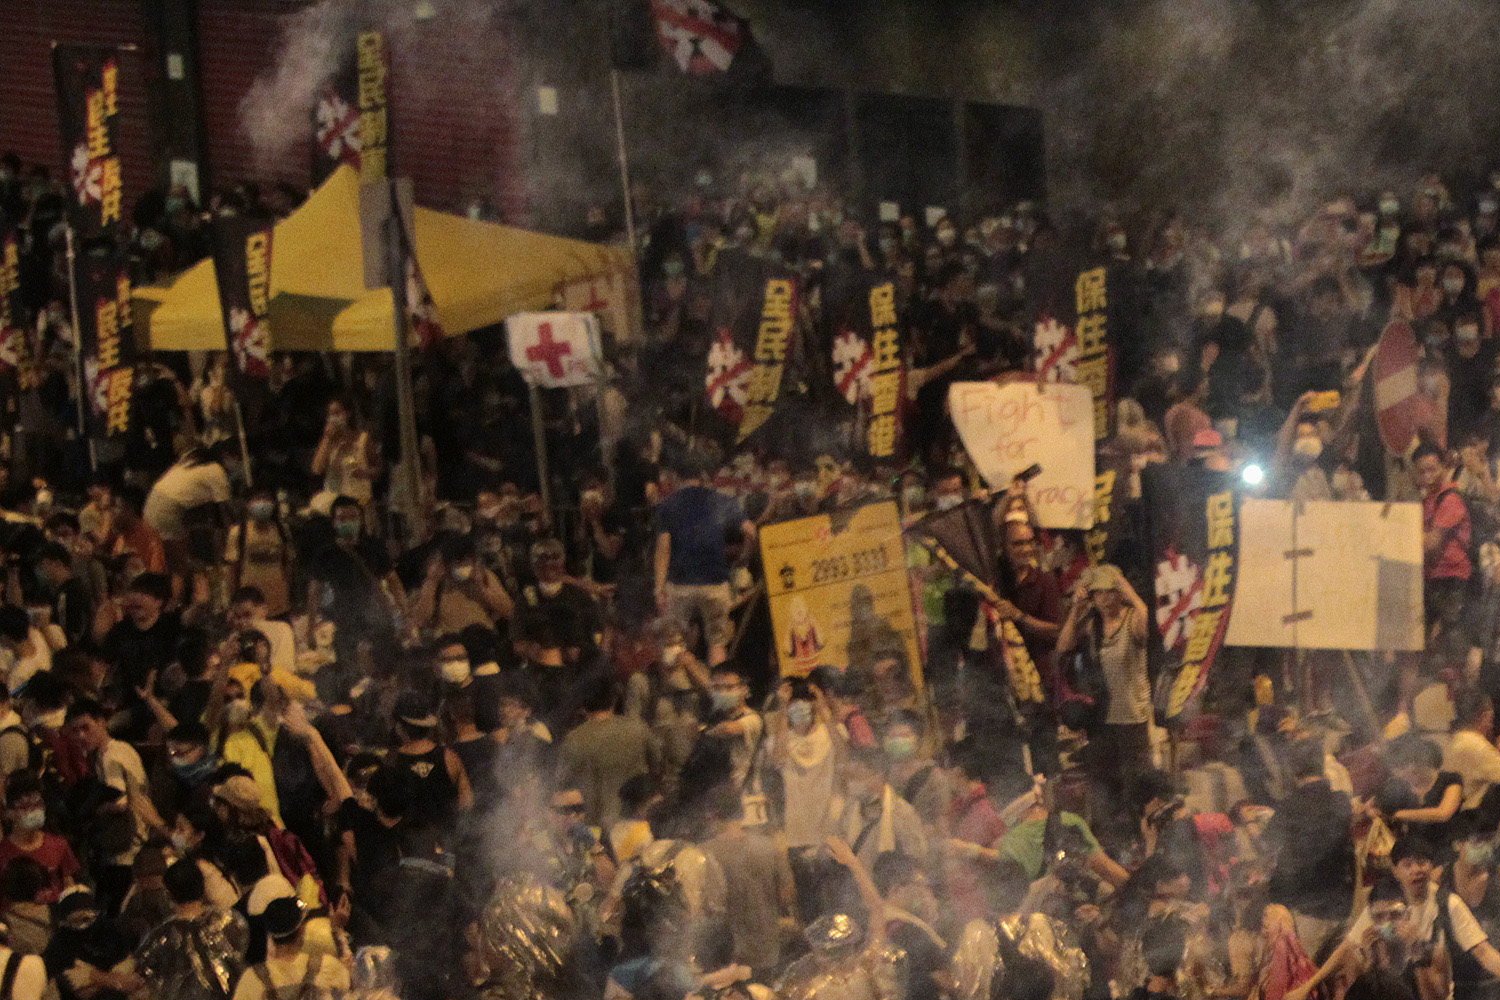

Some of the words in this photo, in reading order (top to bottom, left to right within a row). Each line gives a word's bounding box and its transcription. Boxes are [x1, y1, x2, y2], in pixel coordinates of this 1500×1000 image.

[868, 282, 901, 456] 保住香港
[961, 389, 1077, 437] Fight
[988, 436, 1038, 463] for
[1036, 484, 1088, 516] racy
[1166, 491, 1234, 718] 保住香港
